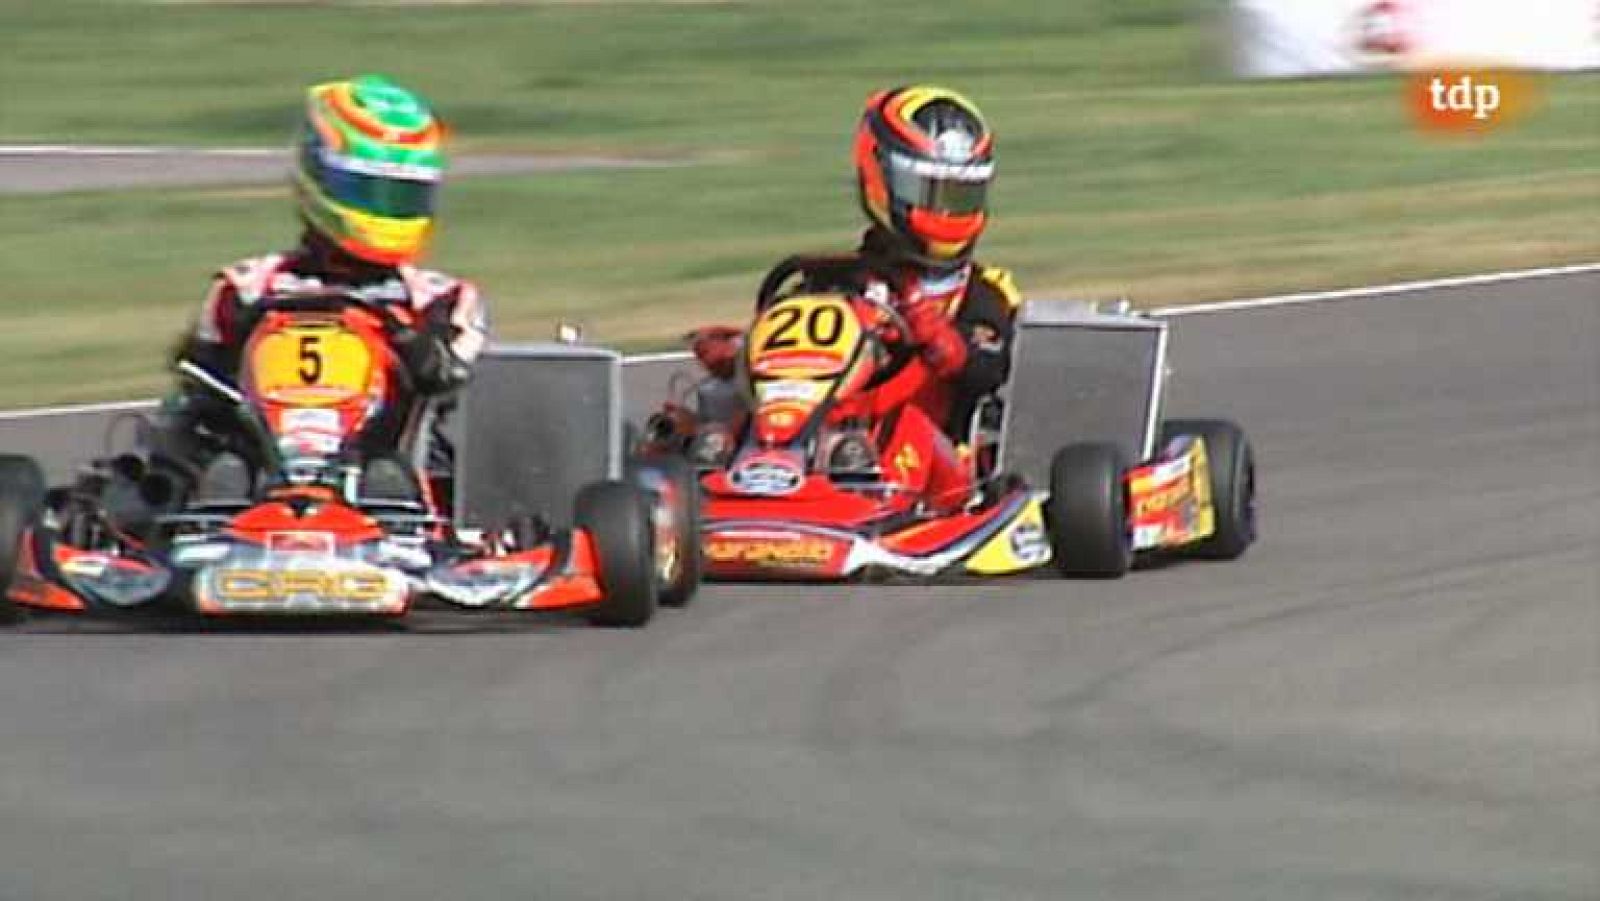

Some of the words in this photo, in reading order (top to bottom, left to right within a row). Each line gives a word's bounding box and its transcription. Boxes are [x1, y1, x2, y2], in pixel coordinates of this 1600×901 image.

[765, 303, 845, 347] 20
[299, 336, 322, 384] 5
[217, 567, 391, 602] CRG
